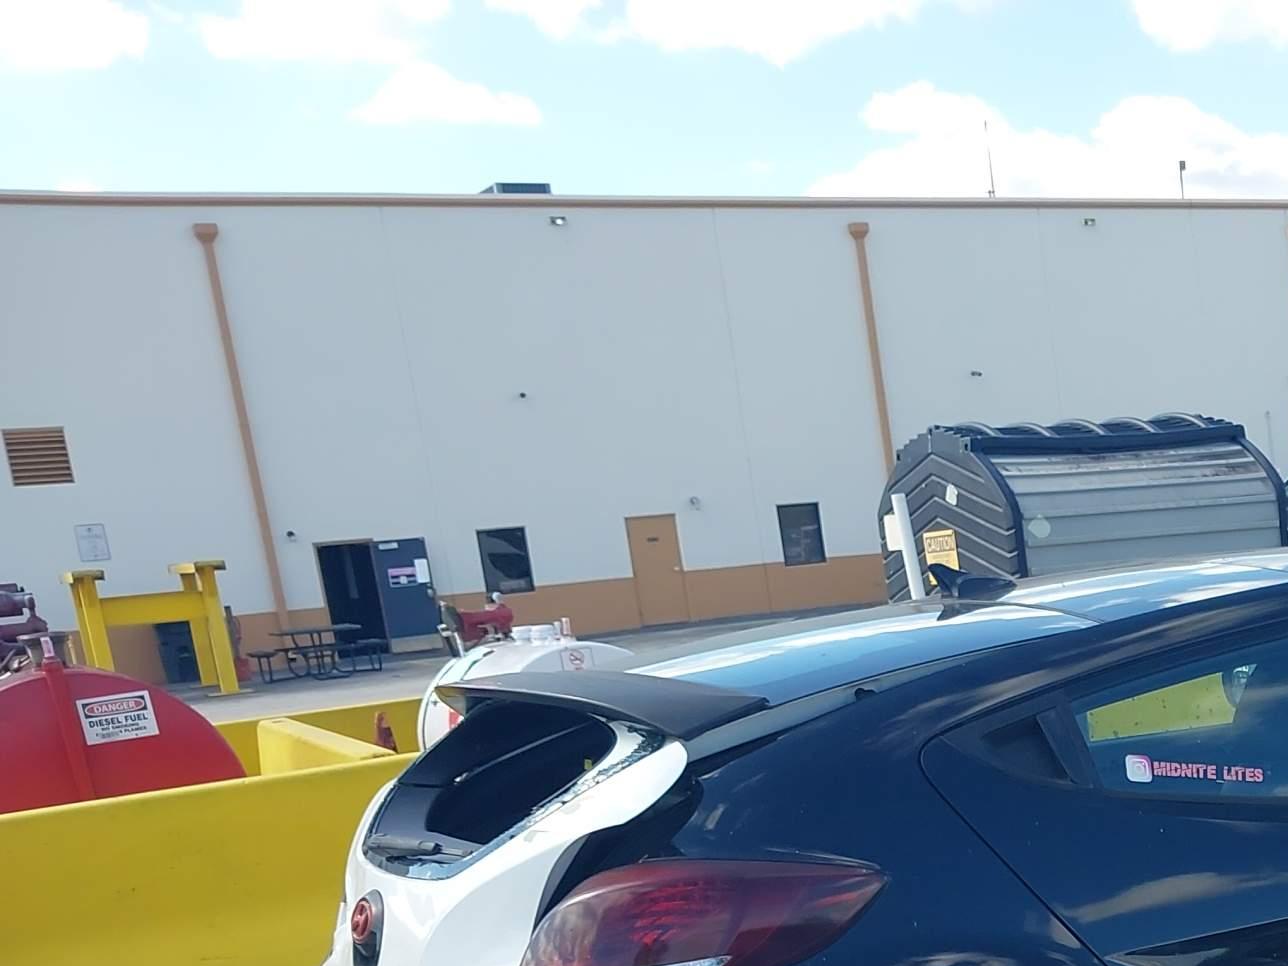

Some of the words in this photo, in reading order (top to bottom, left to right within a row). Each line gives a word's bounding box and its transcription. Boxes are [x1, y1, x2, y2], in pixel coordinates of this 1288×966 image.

[927, 536, 955, 553] CAUTION
[94, 701, 136, 714] DANGER
[88, 717, 122, 728] DIESEL
[124, 713, 148, 723] FUEL
